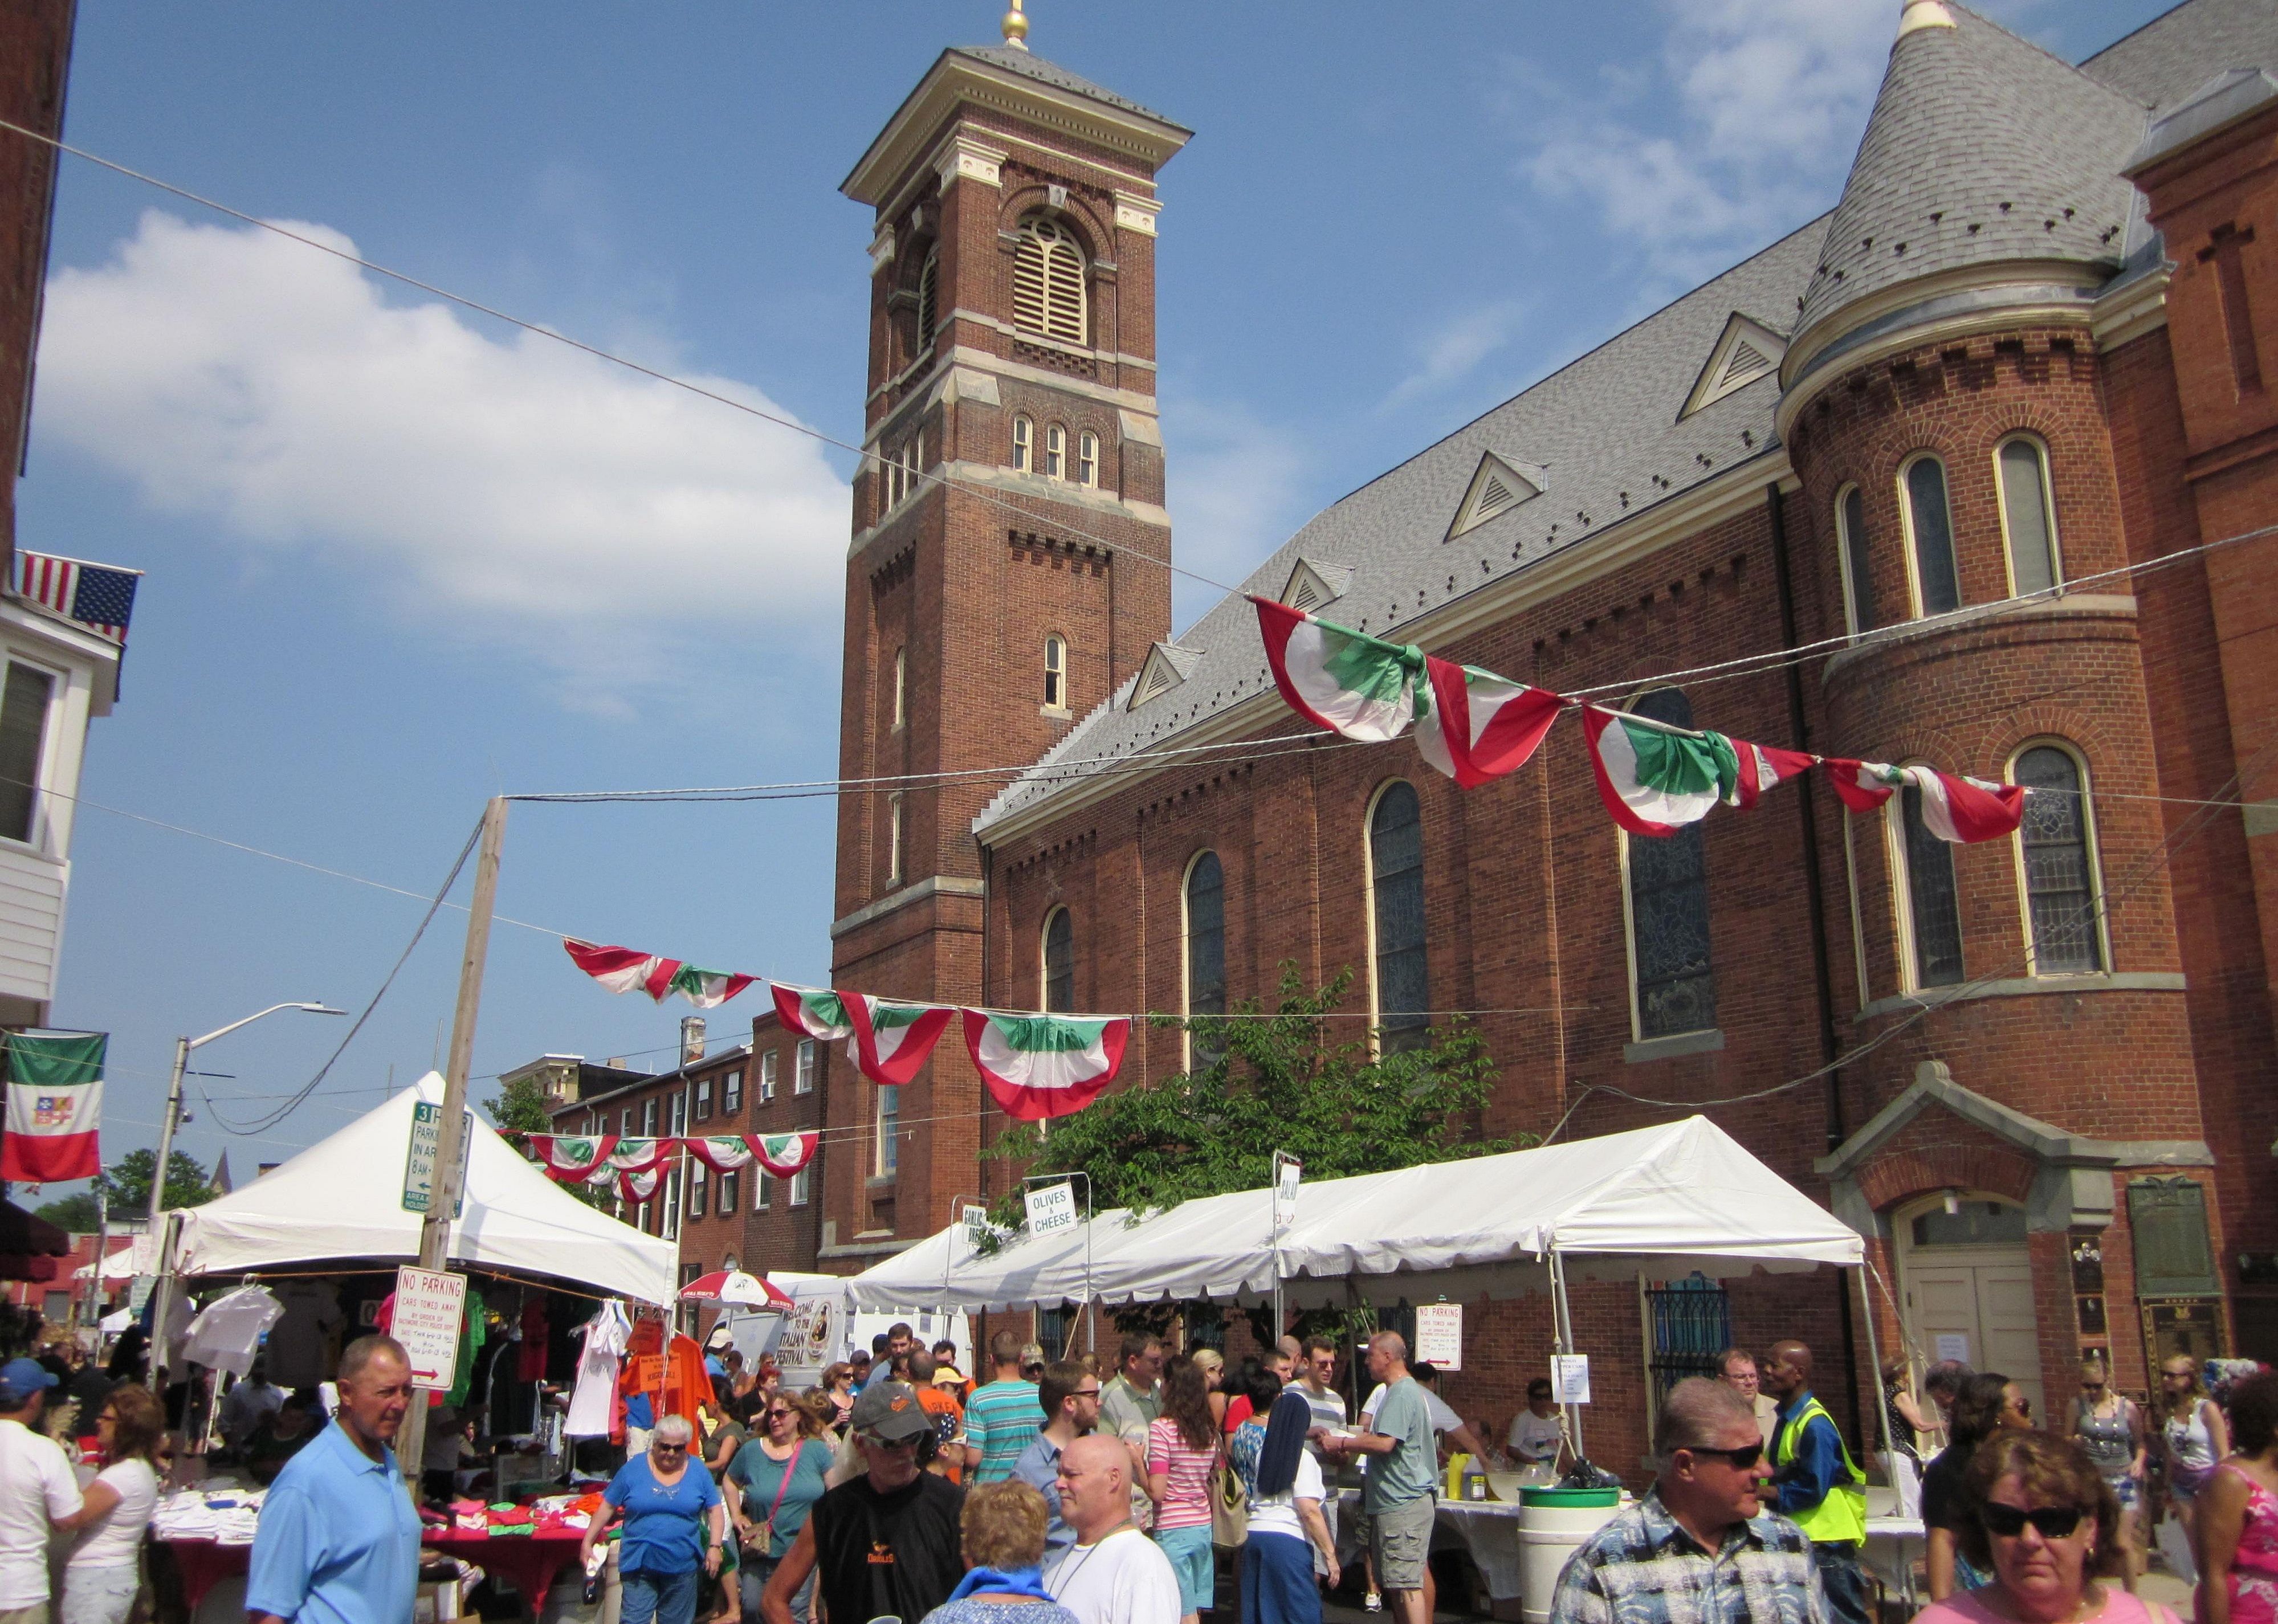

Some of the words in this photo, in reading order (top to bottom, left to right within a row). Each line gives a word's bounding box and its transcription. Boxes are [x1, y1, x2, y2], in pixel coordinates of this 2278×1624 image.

[419, 1105, 427, 1120] 3
[415, 1125, 439, 1142] PARKI
[414, 1142, 422, 1155] IN
[1033, 1190, 1066, 1210] OLIVES
[964, 1210, 983, 1226] GARLIC
[1035, 1211, 1071, 1233] CHEESE
[402, 1274, 415, 1290] NO
[421, 1277, 461, 1297] PARKING
[402, 1297, 417, 1307] CARS
[419, 1300, 438, 1311] TOWED
[783, 1300, 815, 1322] WELCOME
[1420, 1308, 1428, 1316] NO
[1432, 1307, 1459, 1318] PARKING
[779, 1332, 806, 1347] ITALIAN
[775, 1349, 804, 1365] FESTIVAL
